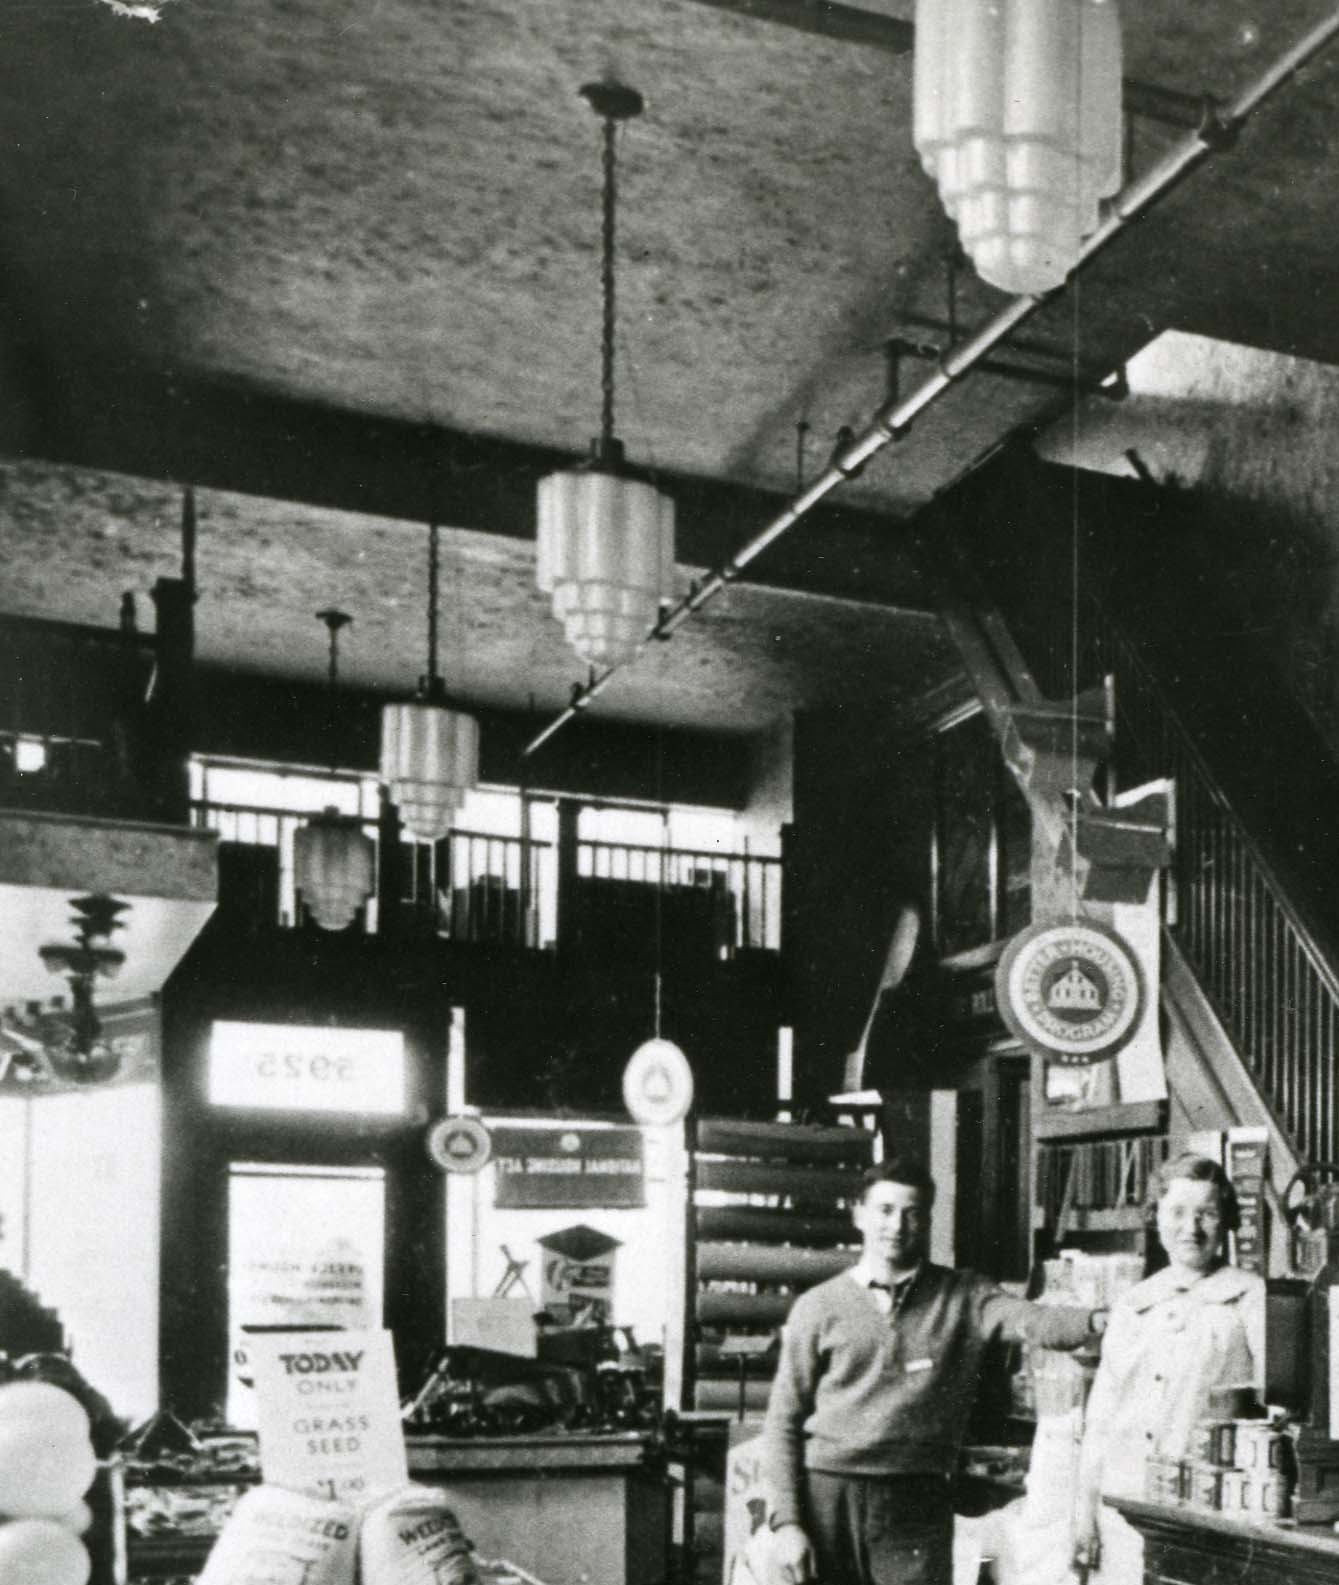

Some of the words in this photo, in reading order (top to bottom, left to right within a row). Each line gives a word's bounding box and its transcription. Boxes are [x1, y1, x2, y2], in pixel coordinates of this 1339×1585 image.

[278, 1351, 364, 1374] TODAY
[296, 1377, 357, 1396] ONLY
[293, 1415, 371, 1435] GRASS
[306, 1436, 360, 1456] SEED
